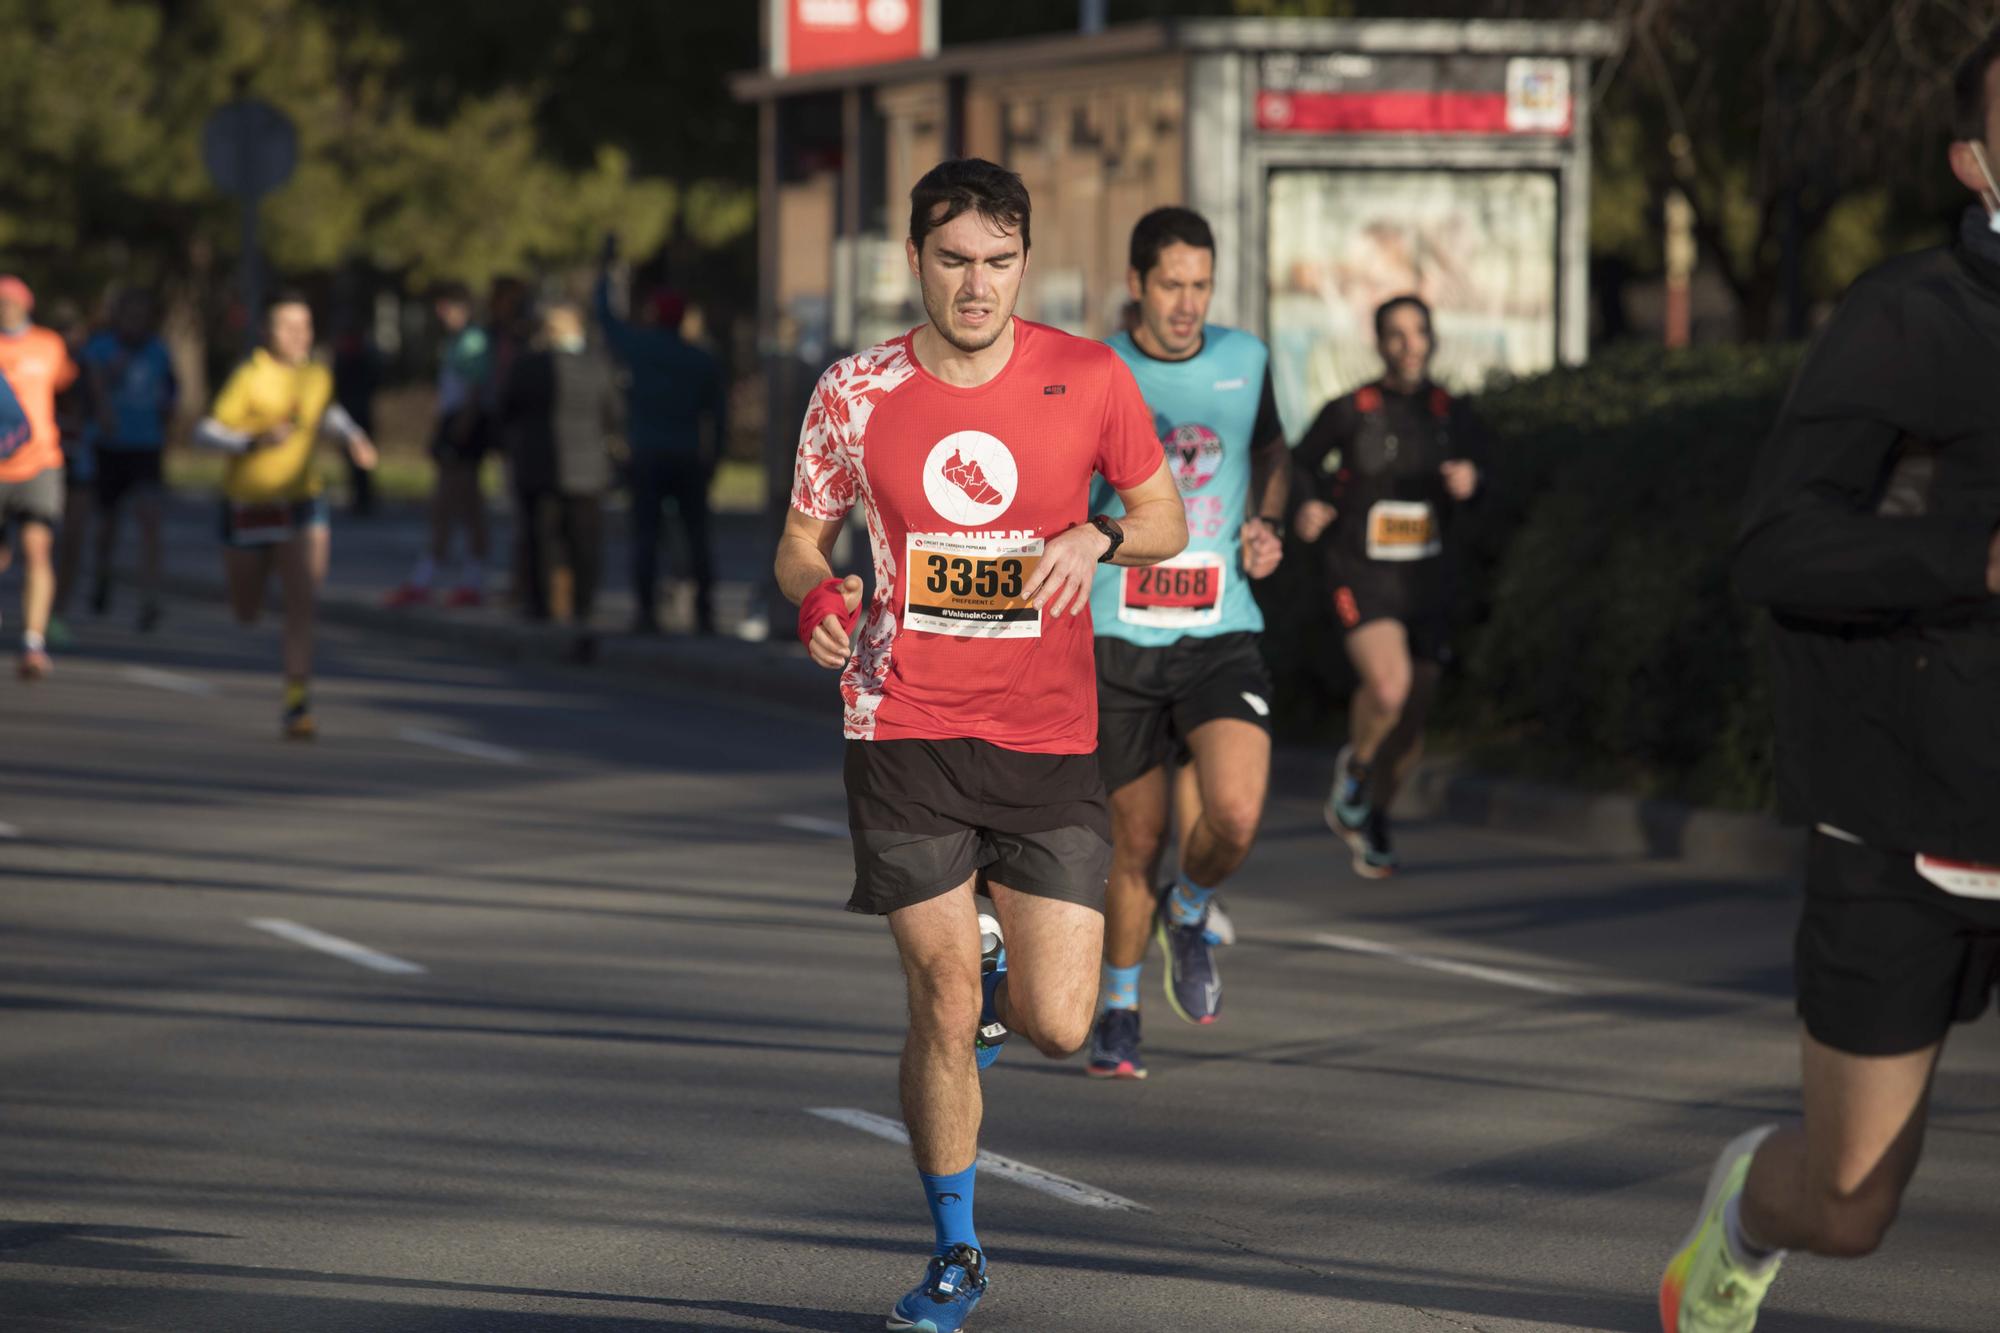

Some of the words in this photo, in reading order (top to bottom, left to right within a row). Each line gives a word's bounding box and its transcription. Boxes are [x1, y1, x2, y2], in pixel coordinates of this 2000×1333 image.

[926, 554, 1023, 598] 3353
[1138, 567, 1208, 596] 2668
[952, 597, 988, 606] PREFERENT
